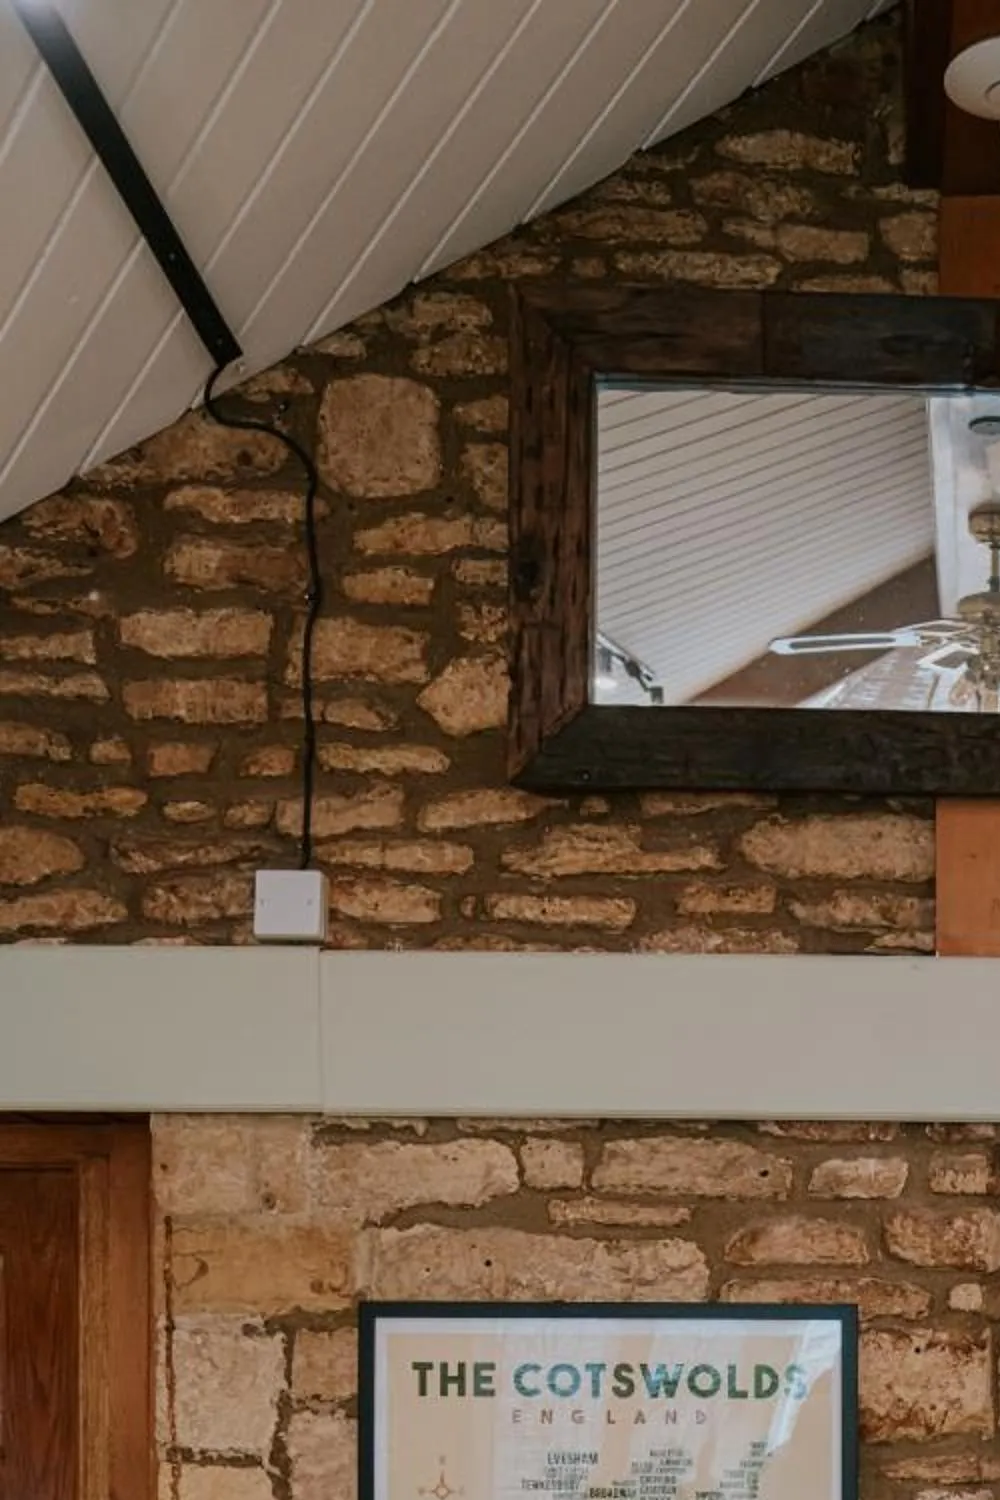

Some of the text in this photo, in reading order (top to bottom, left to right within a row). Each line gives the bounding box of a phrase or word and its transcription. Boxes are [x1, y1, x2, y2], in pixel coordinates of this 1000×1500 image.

[412, 1361, 808, 1399] THE COTSWOLDS
[511, 1409, 708, 1425] ENGLAND
[547, 1451, 599, 1465] EVESHAM
